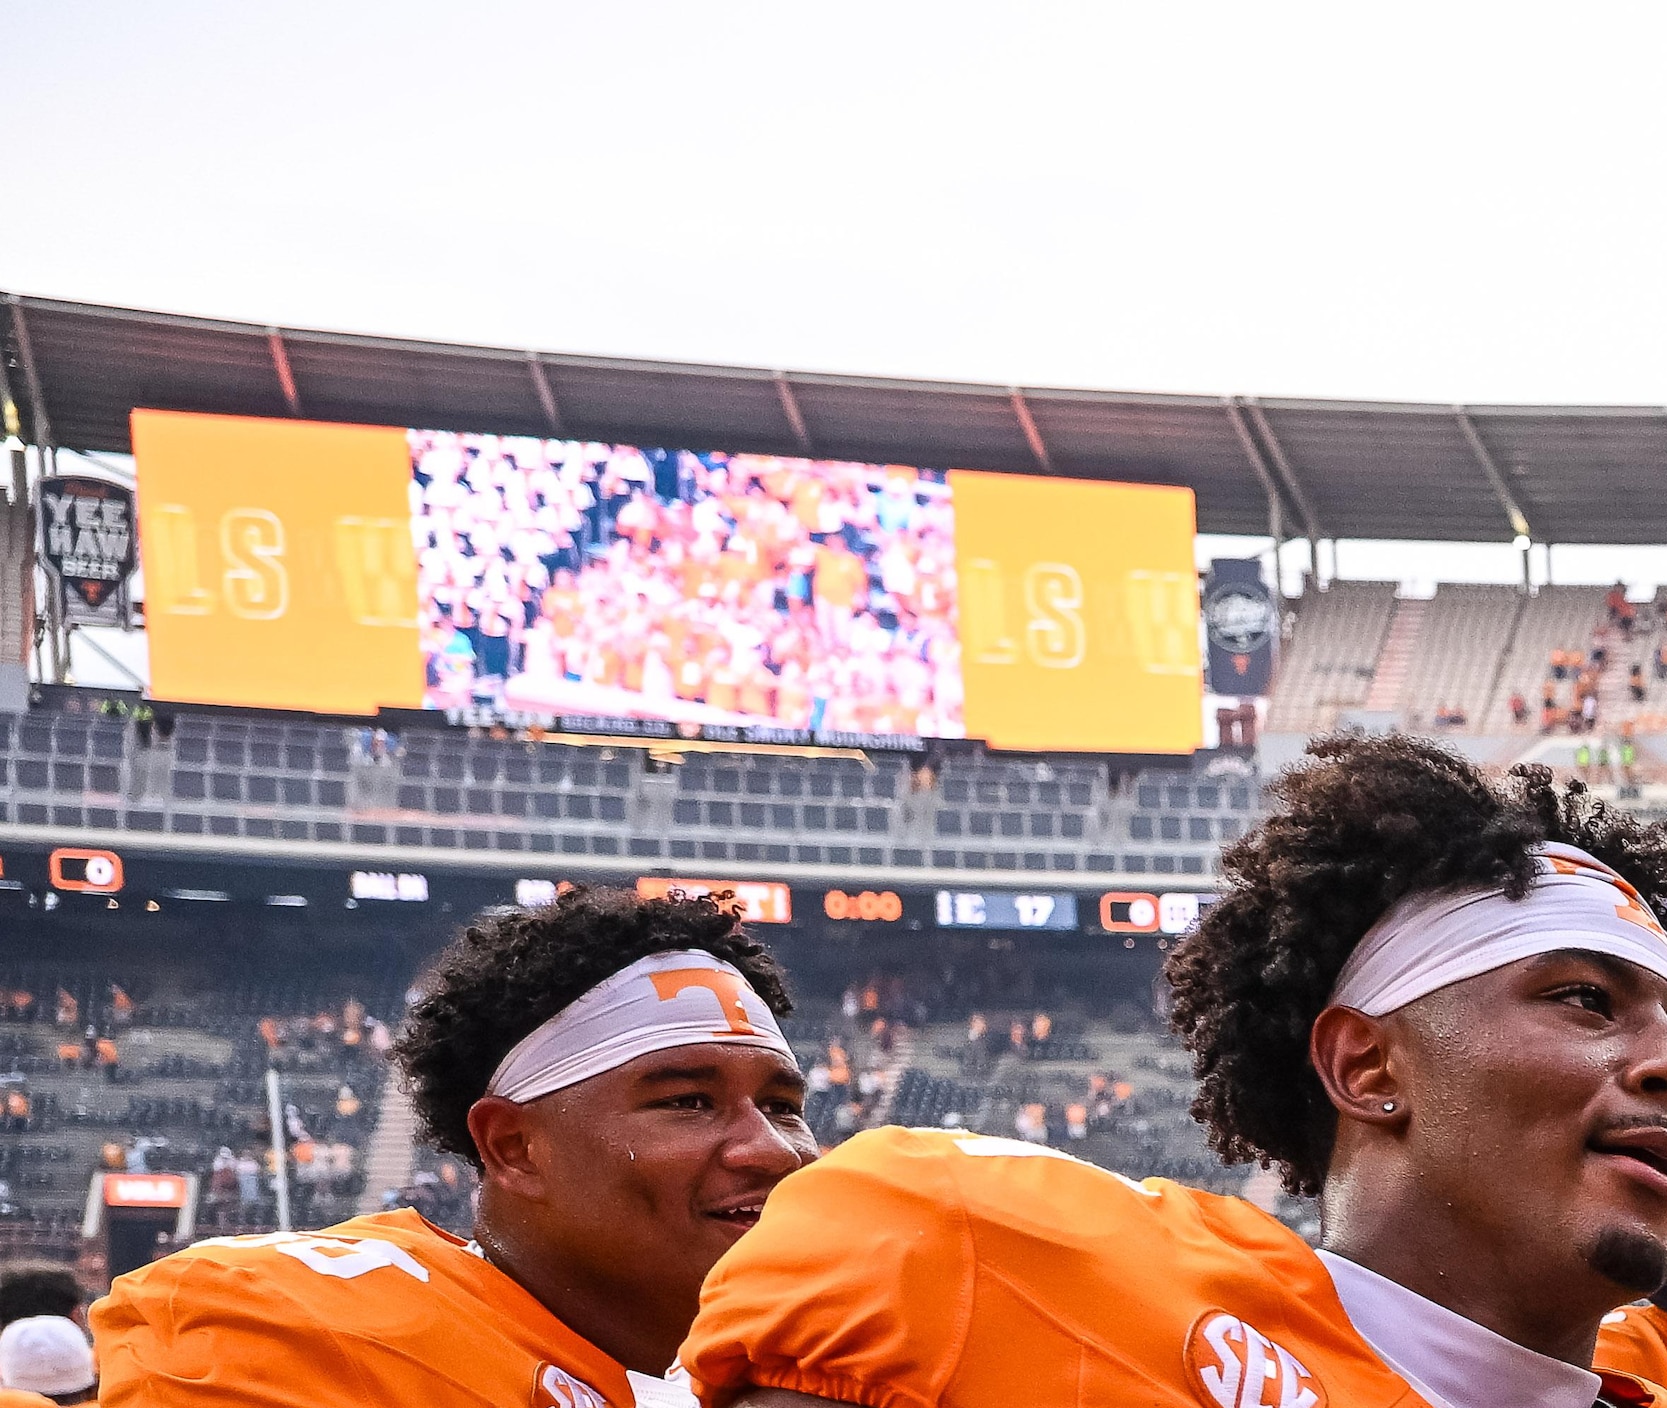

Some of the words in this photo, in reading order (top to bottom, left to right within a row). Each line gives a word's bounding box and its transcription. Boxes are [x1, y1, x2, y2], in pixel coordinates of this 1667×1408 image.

[45, 493, 127, 528] YEE
[48, 524, 130, 561] HAW
[1015, 895, 1055, 926] 17
[650, 968, 760, 1037] T
